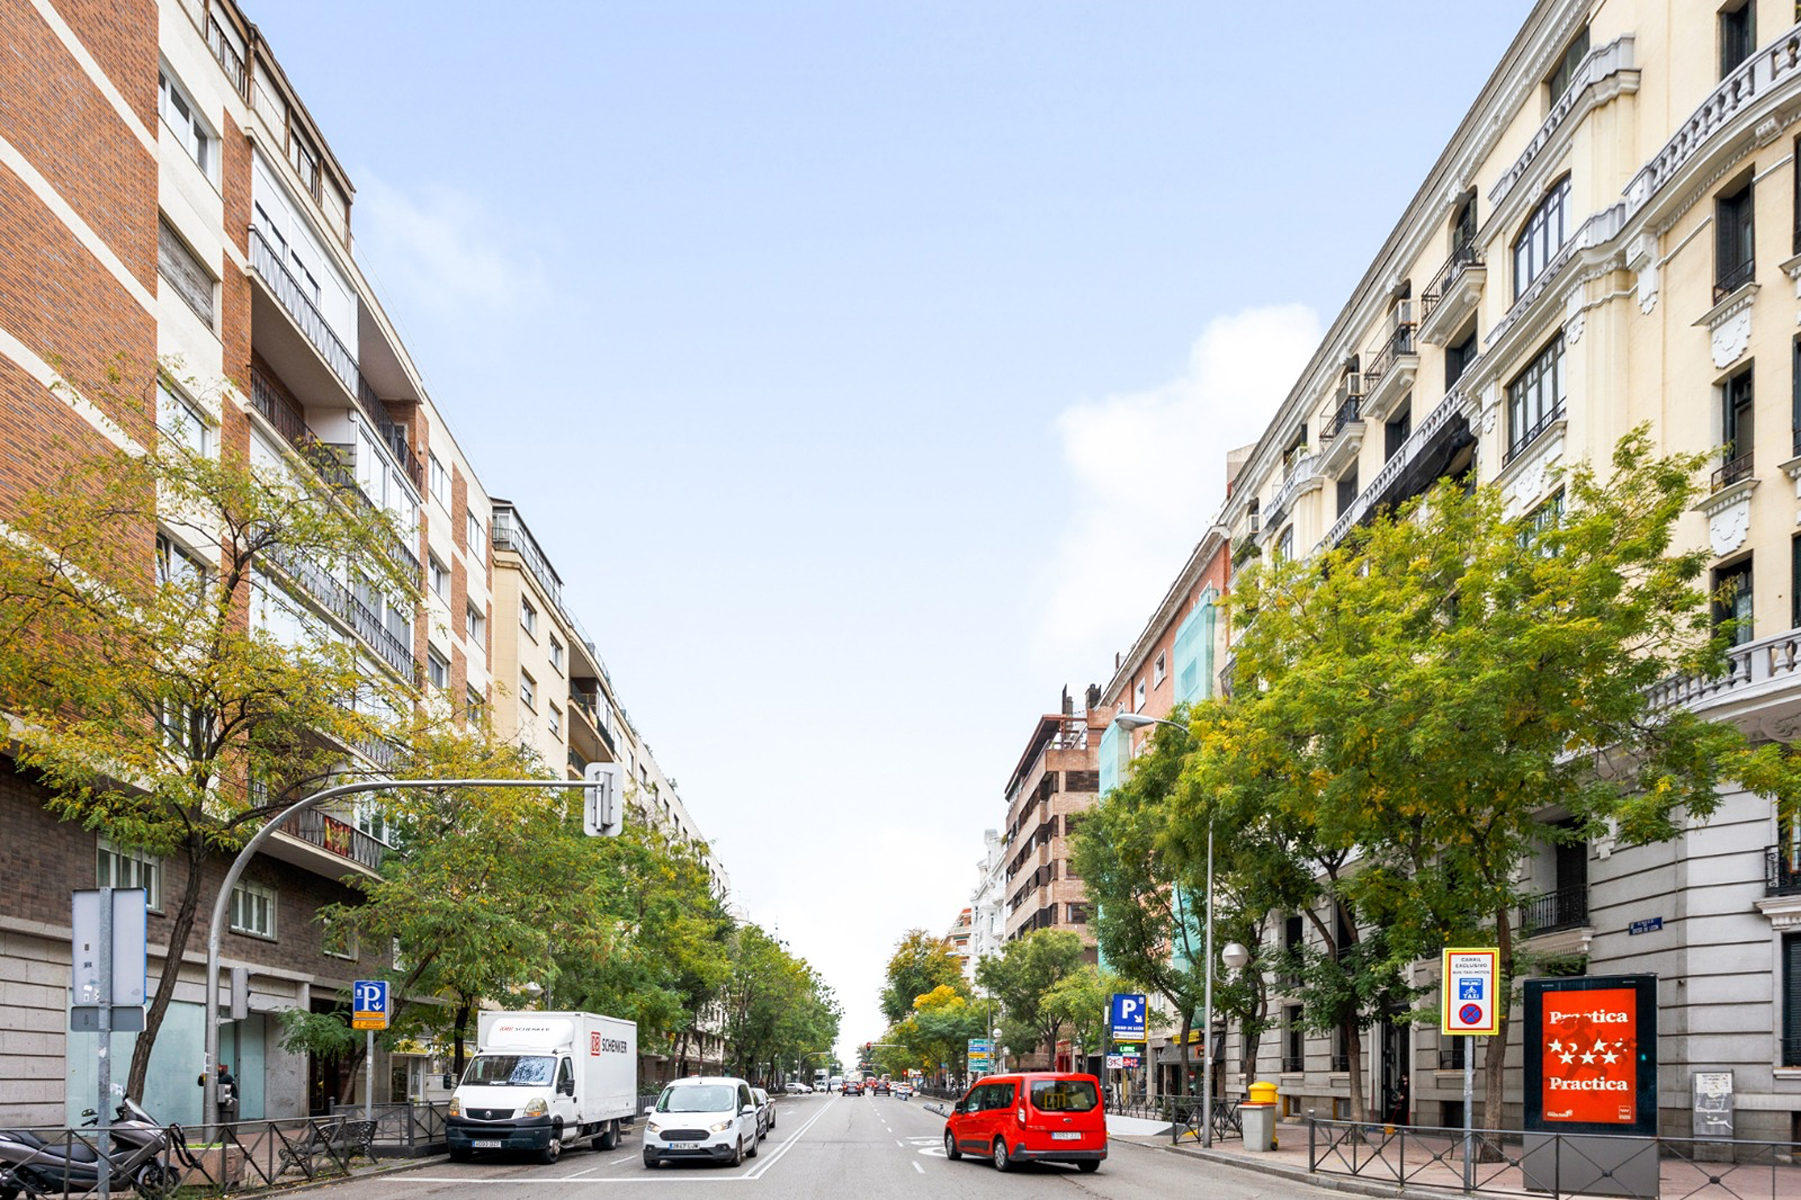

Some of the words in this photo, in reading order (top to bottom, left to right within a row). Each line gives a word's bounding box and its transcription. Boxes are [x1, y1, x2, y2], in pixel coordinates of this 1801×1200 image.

[361, 985, 381, 1011] P
[1122, 999, 1137, 1018] P
[591, 1032, 600, 1056] DB
[602, 1038, 627, 1053] SCHENKER
[1549, 1076, 1629, 1091] Practica
